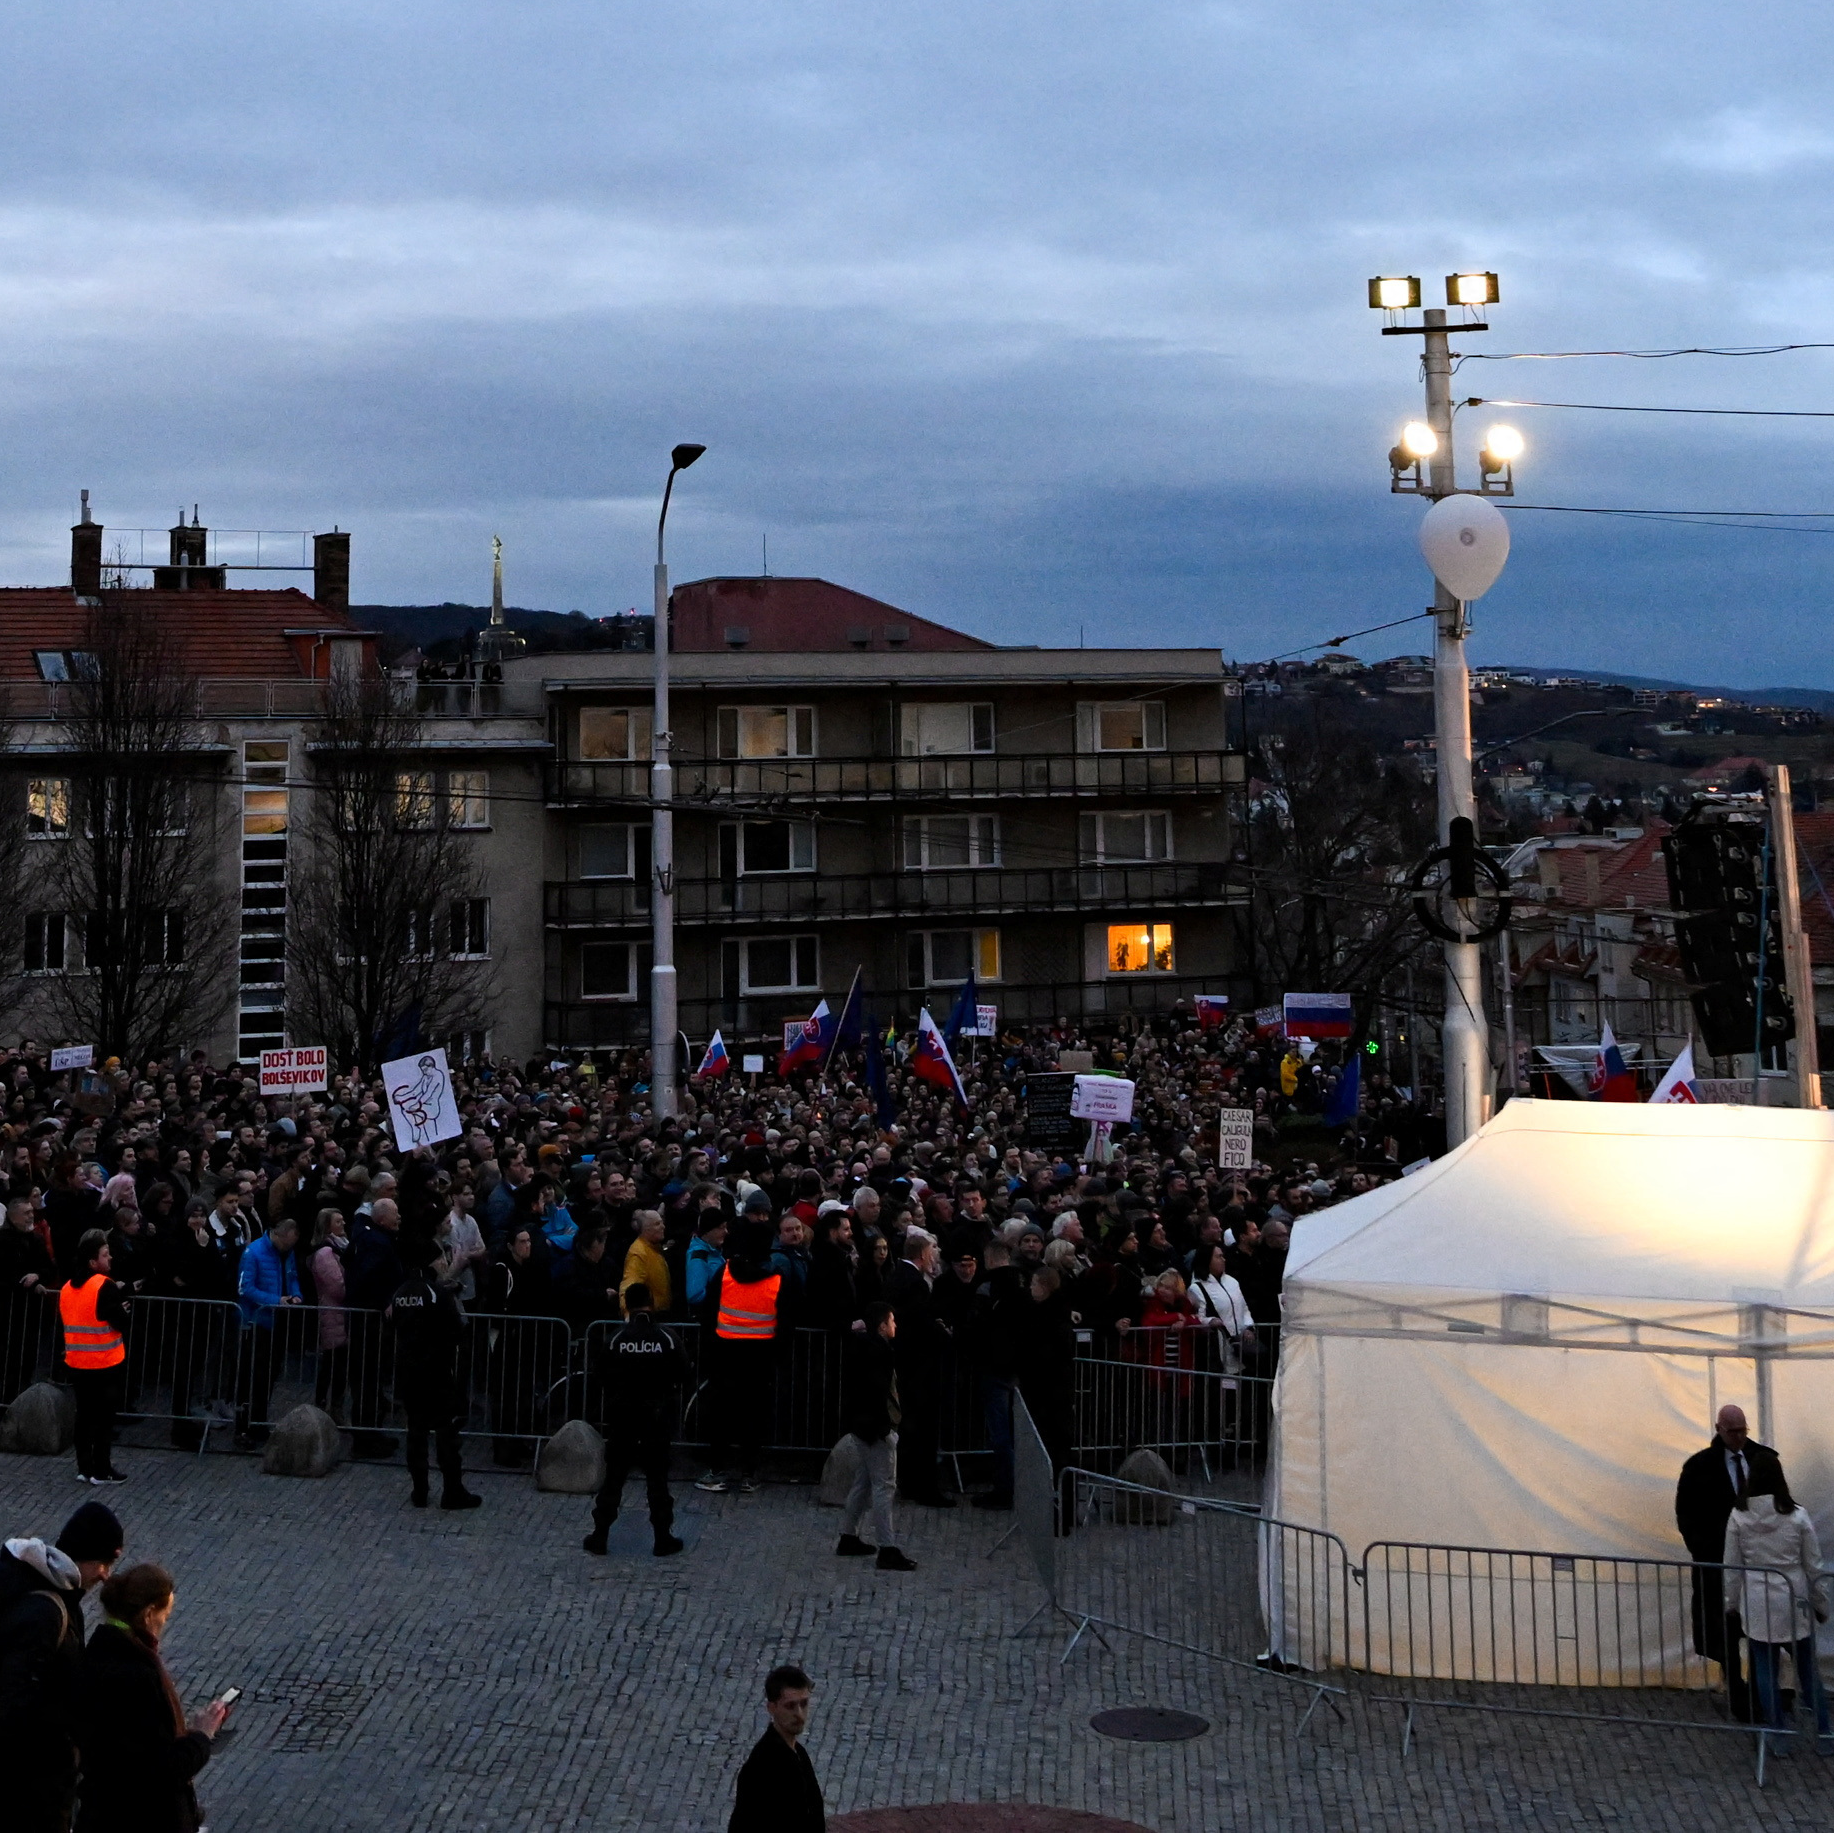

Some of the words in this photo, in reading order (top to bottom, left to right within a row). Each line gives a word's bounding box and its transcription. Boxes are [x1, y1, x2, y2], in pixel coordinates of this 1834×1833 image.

[263, 1050, 293, 1068] DOSŤ
[296, 1050, 324, 1066] BOLO
[262, 1069, 325, 1085] BOLŠEVIKOV
[1223, 1110, 1252, 1123] CAESAR
[1225, 1138, 1247, 1151] NERO
[1224, 1152, 1244, 1166] FICO
[620, 1340, 662, 1353] POLÍCIA
